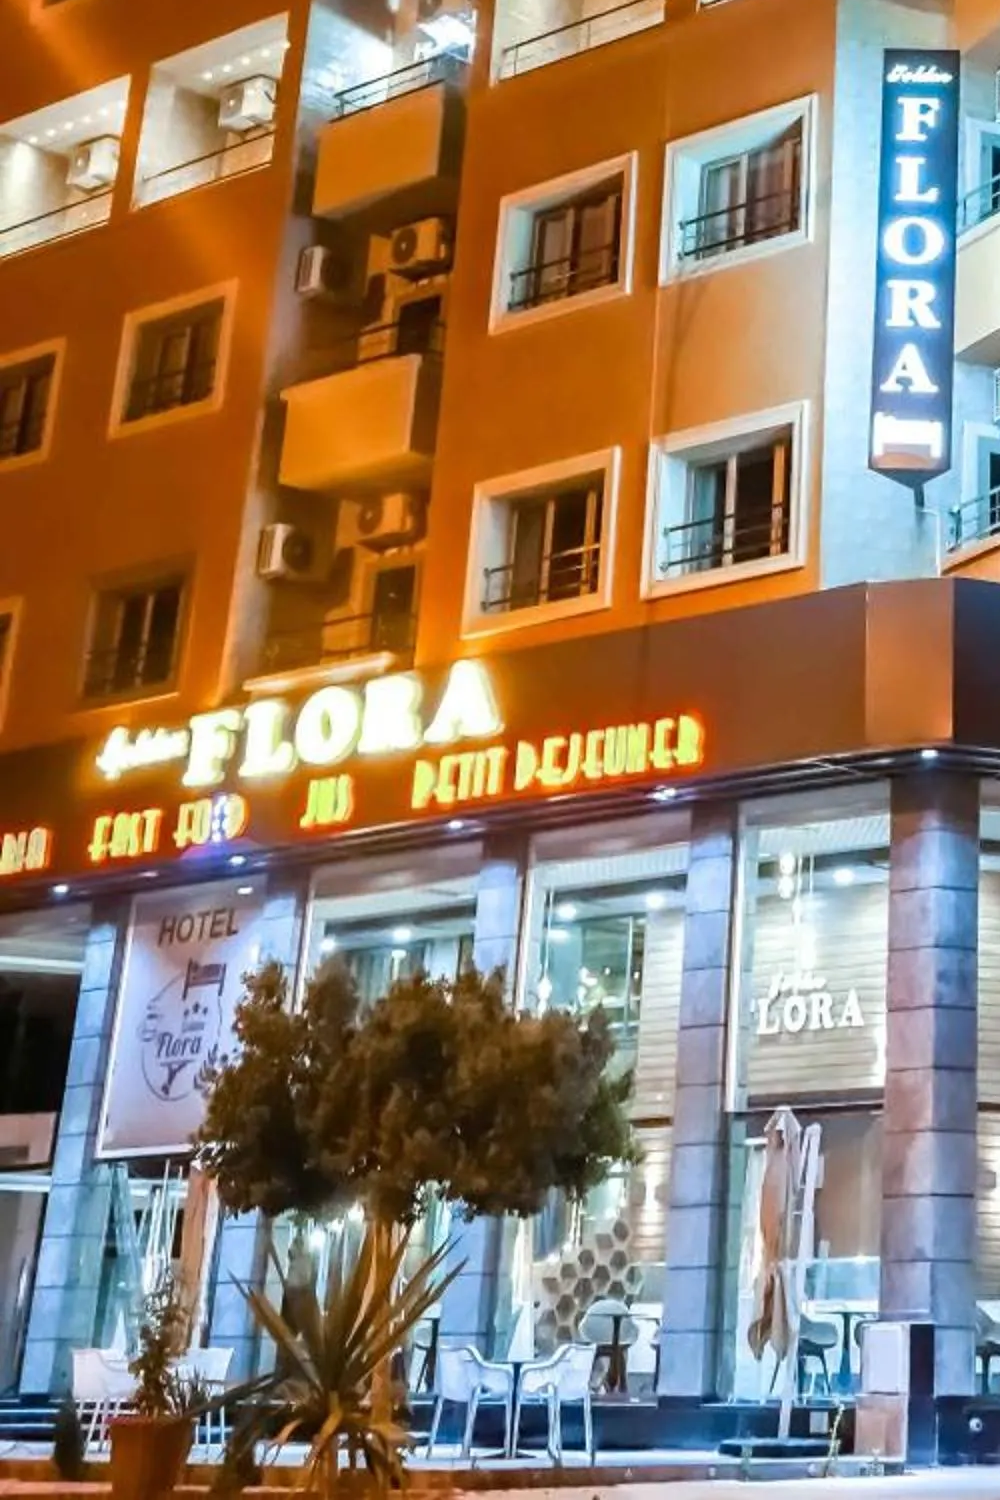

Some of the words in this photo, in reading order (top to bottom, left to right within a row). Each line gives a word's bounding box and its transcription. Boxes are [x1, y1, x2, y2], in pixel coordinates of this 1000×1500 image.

[879, 96, 947, 393] FLORA
[182, 658, 504, 788] FLORA
[412, 747, 506, 809] PETIT
[514, 715, 701, 791] DEJEUNER
[301, 775, 353, 828] JUS
[88, 809, 162, 862] FAST
[158, 908, 240, 946] HOTEL
[750, 988, 864, 1035] LORA
